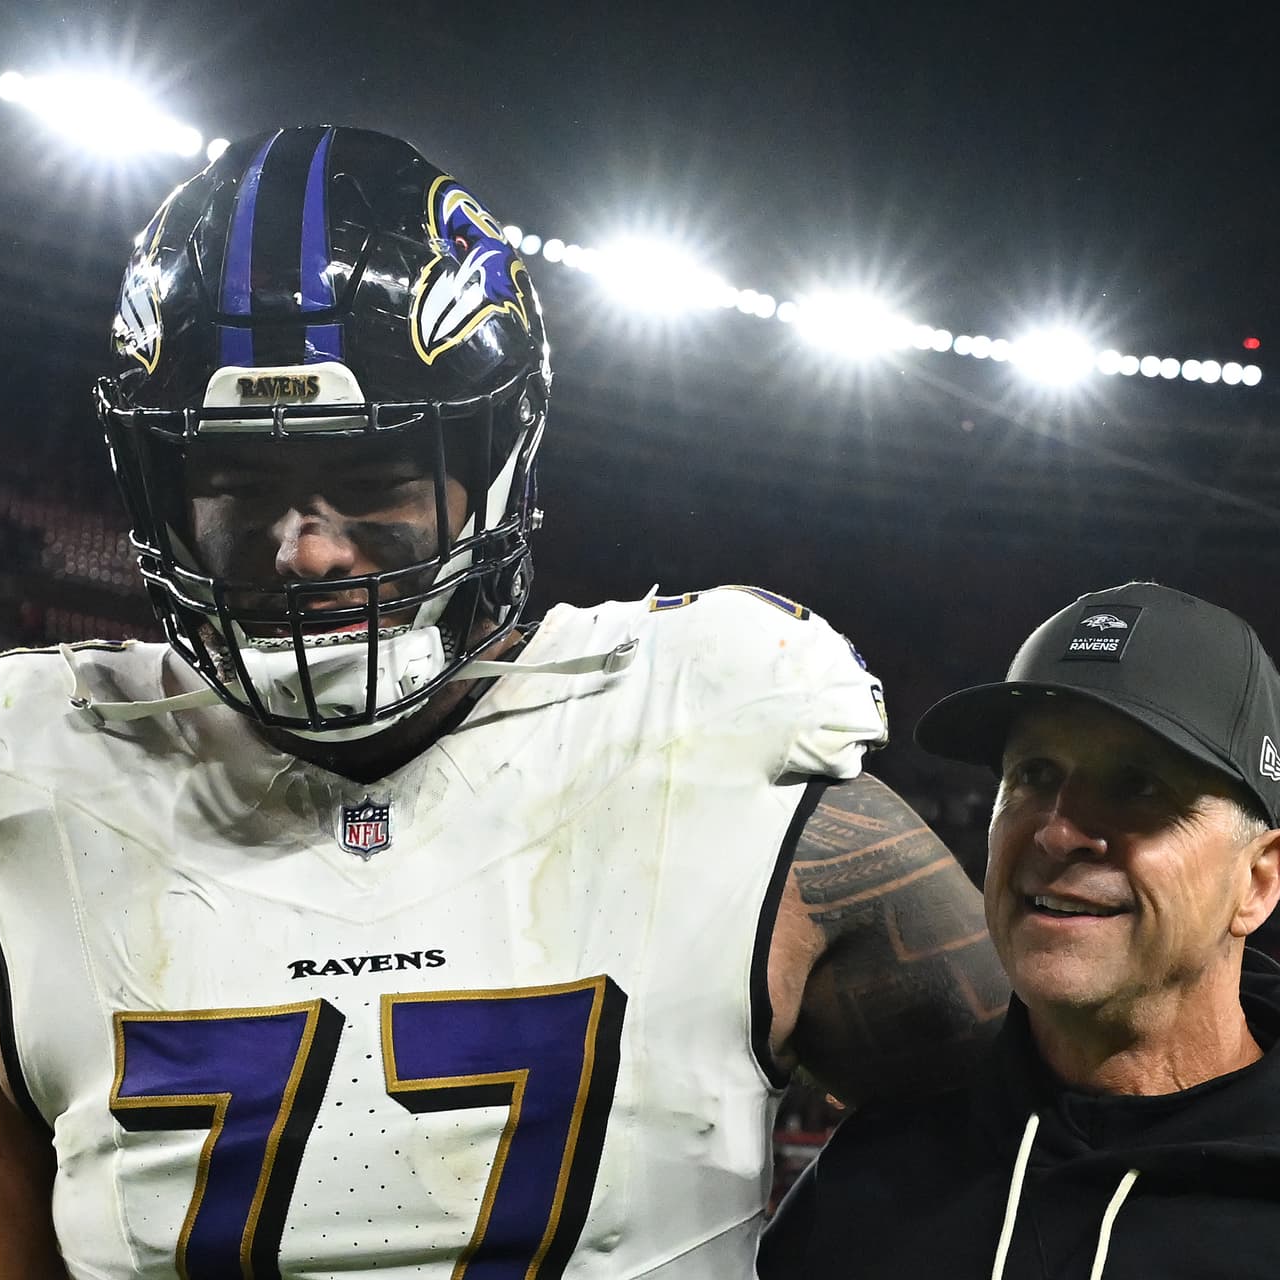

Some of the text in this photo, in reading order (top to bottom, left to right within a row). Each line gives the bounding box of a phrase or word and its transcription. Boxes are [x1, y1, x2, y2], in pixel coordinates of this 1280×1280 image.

[237, 374, 320, 400] RAVENS
[1069, 642, 1118, 651] RAVENS
[348, 823, 385, 846] NFL
[287, 949, 447, 979] RAVENS
